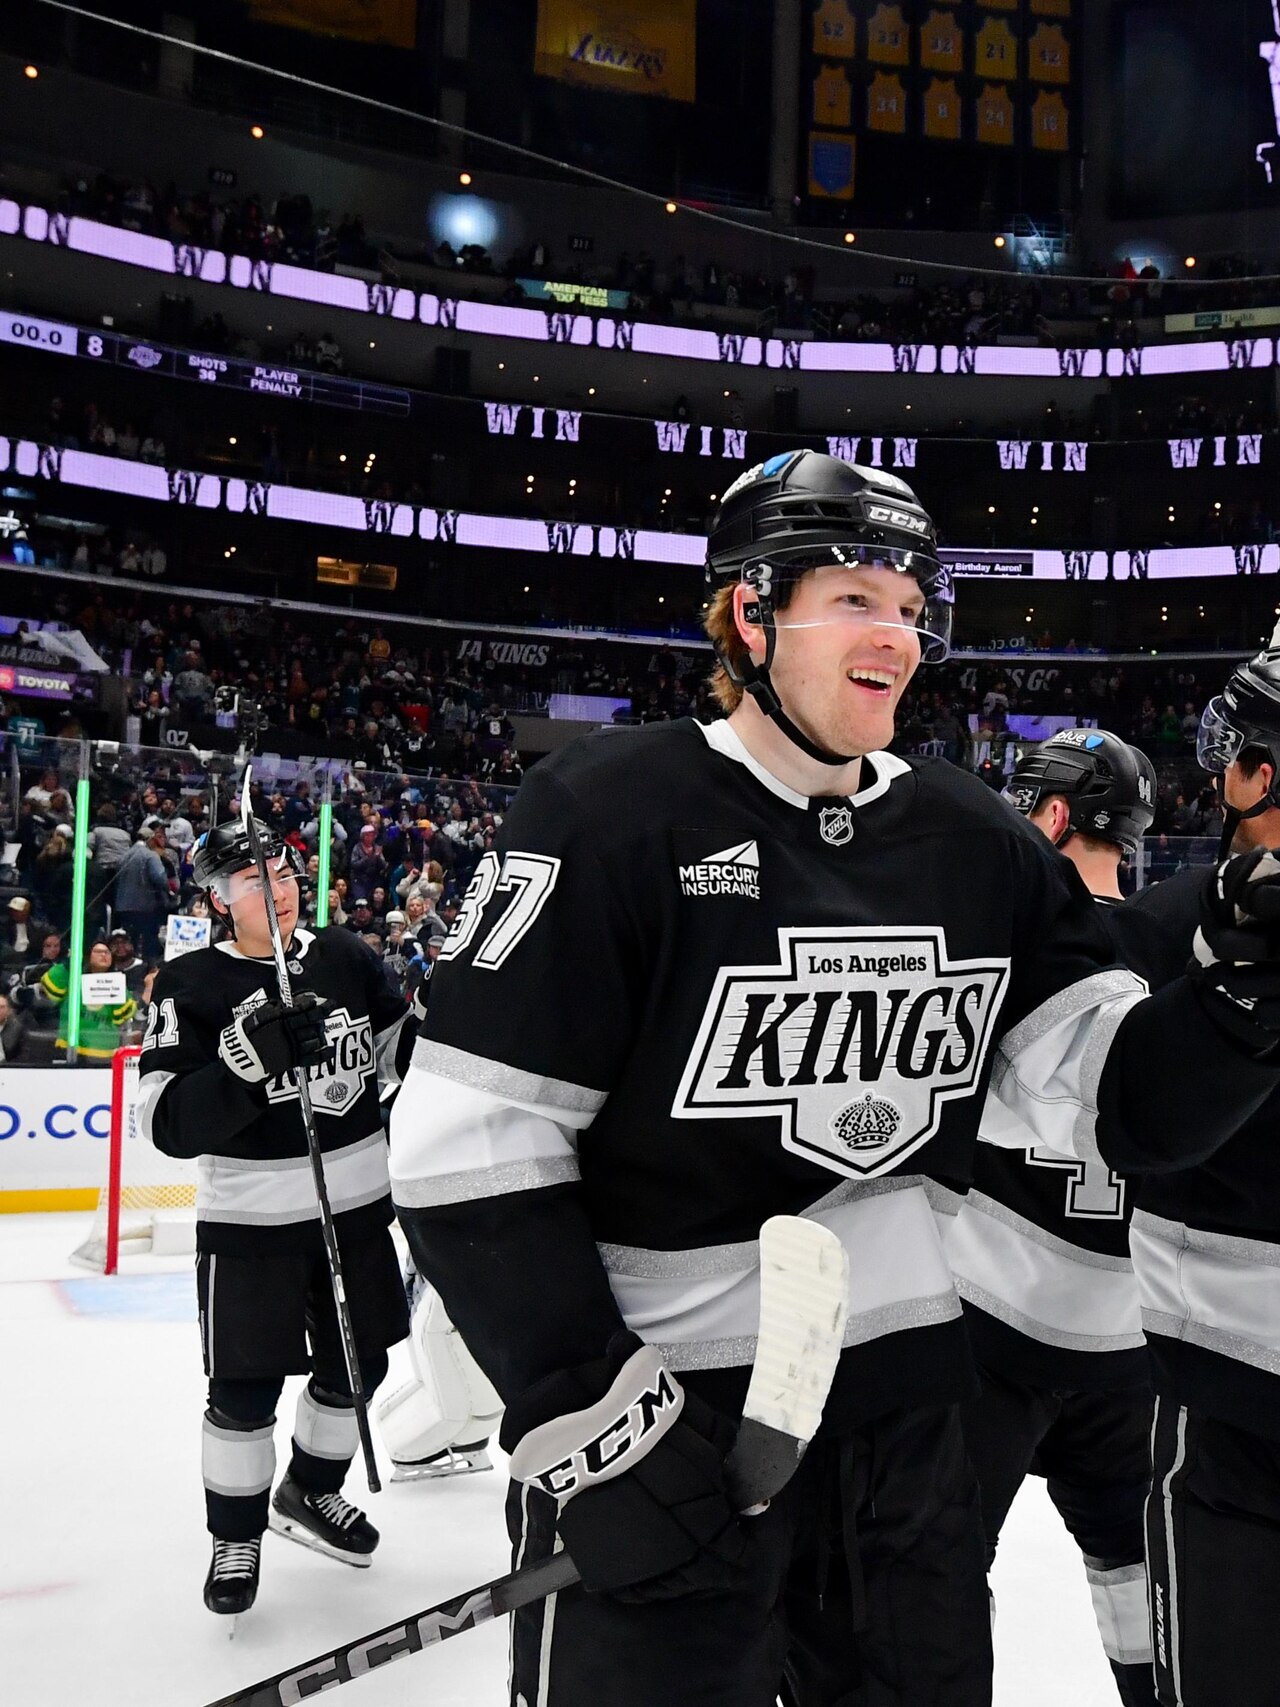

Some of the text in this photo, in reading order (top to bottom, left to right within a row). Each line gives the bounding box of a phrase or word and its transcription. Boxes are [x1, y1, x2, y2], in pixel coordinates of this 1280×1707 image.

[173, 243, 272, 293] WIN
[365, 280, 458, 330] WIN
[543, 281, 607, 298] AMERICAN
[11, 321, 62, 346] 00.0
[546, 310, 634, 350] WIN
[87, 335, 103, 357] 8
[716, 332, 802, 369] WIN
[890, 343, 978, 374] WIN
[1055, 346, 1144, 377] WIN
[188, 355, 227, 372] SHOTS
[255, 366, 299, 384] PLAYER
[250, 378, 302, 397] PENALTY
[484, 402, 582, 442] WIN
[654, 420, 748, 459] WIN
[826, 437, 918, 467] WIN
[1167, 434, 1263, 468] WIN
[996, 440, 1088, 471] WIN
[164, 467, 271, 516] WIN
[361, 498, 460, 543] WIN
[868, 504, 928, 534] CCM
[544, 521, 637, 560] WIN
[955, 562, 990, 574] Birthday
[994, 562, 1023, 573] Aaron!
[1061, 549, 1151, 580] WIN
[18, 674, 70, 691] TOYOTA
[1055, 731, 1087, 743] blue
[826, 815, 847, 838] NHL
[678, 865, 760, 886] MERCURY
[681, 880, 761, 900] INSURANCE
[808, 953, 927, 977] Los Angeles
[222, 1026, 255, 1070] WAR
[715, 982, 984, 1090] KINGS
[525, 1366, 678, 1498] CCM
[1155, 1582, 1167, 1669] BAUER
[278, 1587, 497, 1707] CCM
